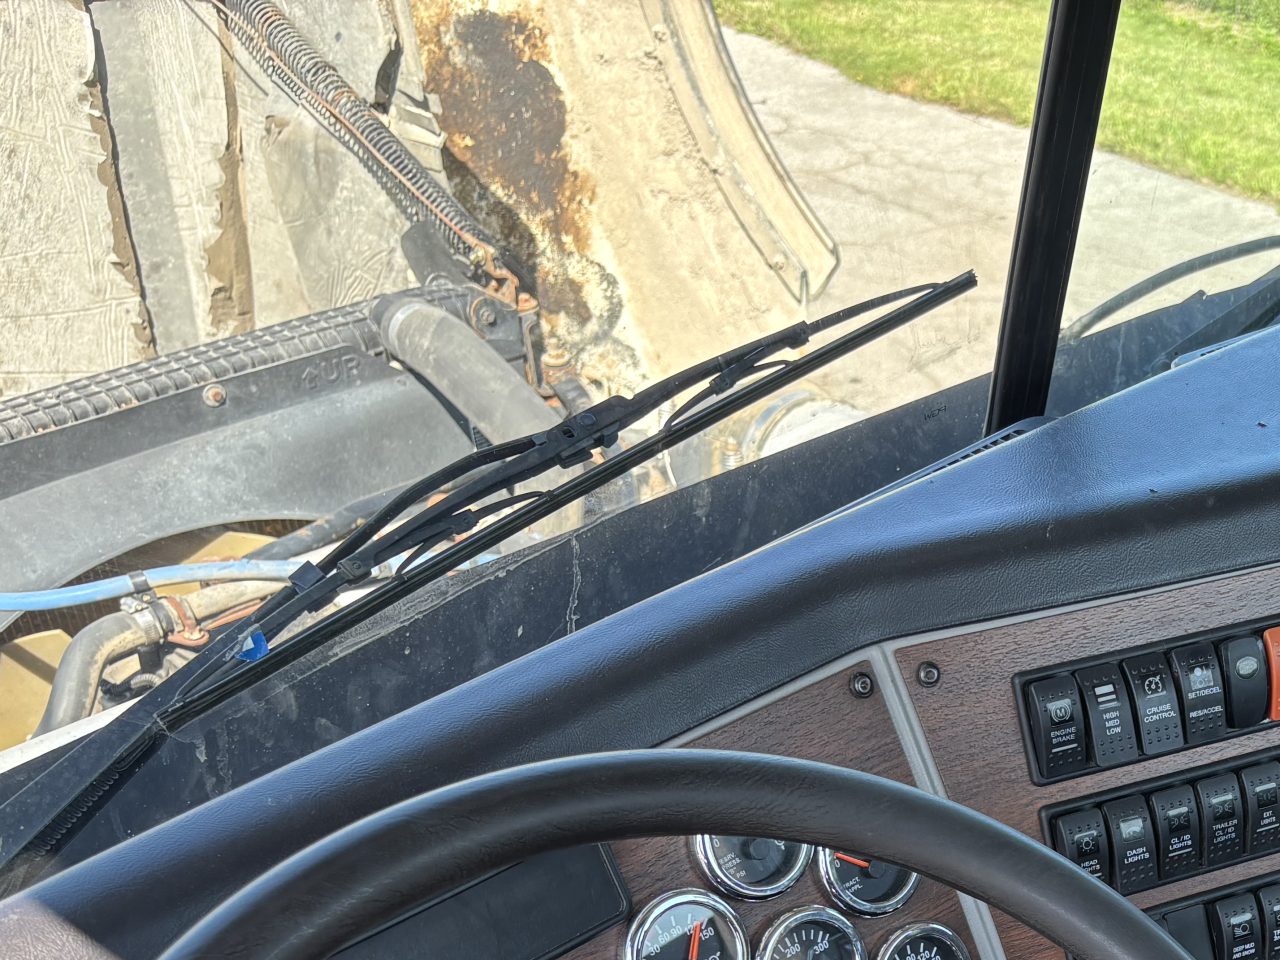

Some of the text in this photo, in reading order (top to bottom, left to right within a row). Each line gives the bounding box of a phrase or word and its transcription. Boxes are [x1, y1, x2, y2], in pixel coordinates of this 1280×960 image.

[1103, 710, 1120, 720] HIGH
[1146, 703, 1172, 715] CRUISE
[1105, 718, 1120, 728] MED
[1144, 711, 1177, 723] CONTROL
[1050, 726, 1077, 738] ENGINE
[1106, 726, 1121, 736] LOW
[1052, 733, 1076, 745] BRAKE
[1212, 819, 1238, 832] TRAILER
[1261, 815, 1276, 825] LIGHTS
[714, 839, 720, 847] 0
[1213, 832, 1236, 844] LIGHTS
[1169, 839, 1192, 850] LIGHTS
[1126, 846, 1147, 857] DASH
[834, 859, 840, 868] 0
[1080, 859, 1098, 868] HEAD
[1124, 852, 1150, 865] LIGHTS
[671, 926, 682, 937] 90
[700, 927, 714, 940] 150
[658, 932, 669, 944] 60
[649, 944, 661, 956] 30
[785, 944, 801, 958] 200
[813, 941, 829, 954] 300
